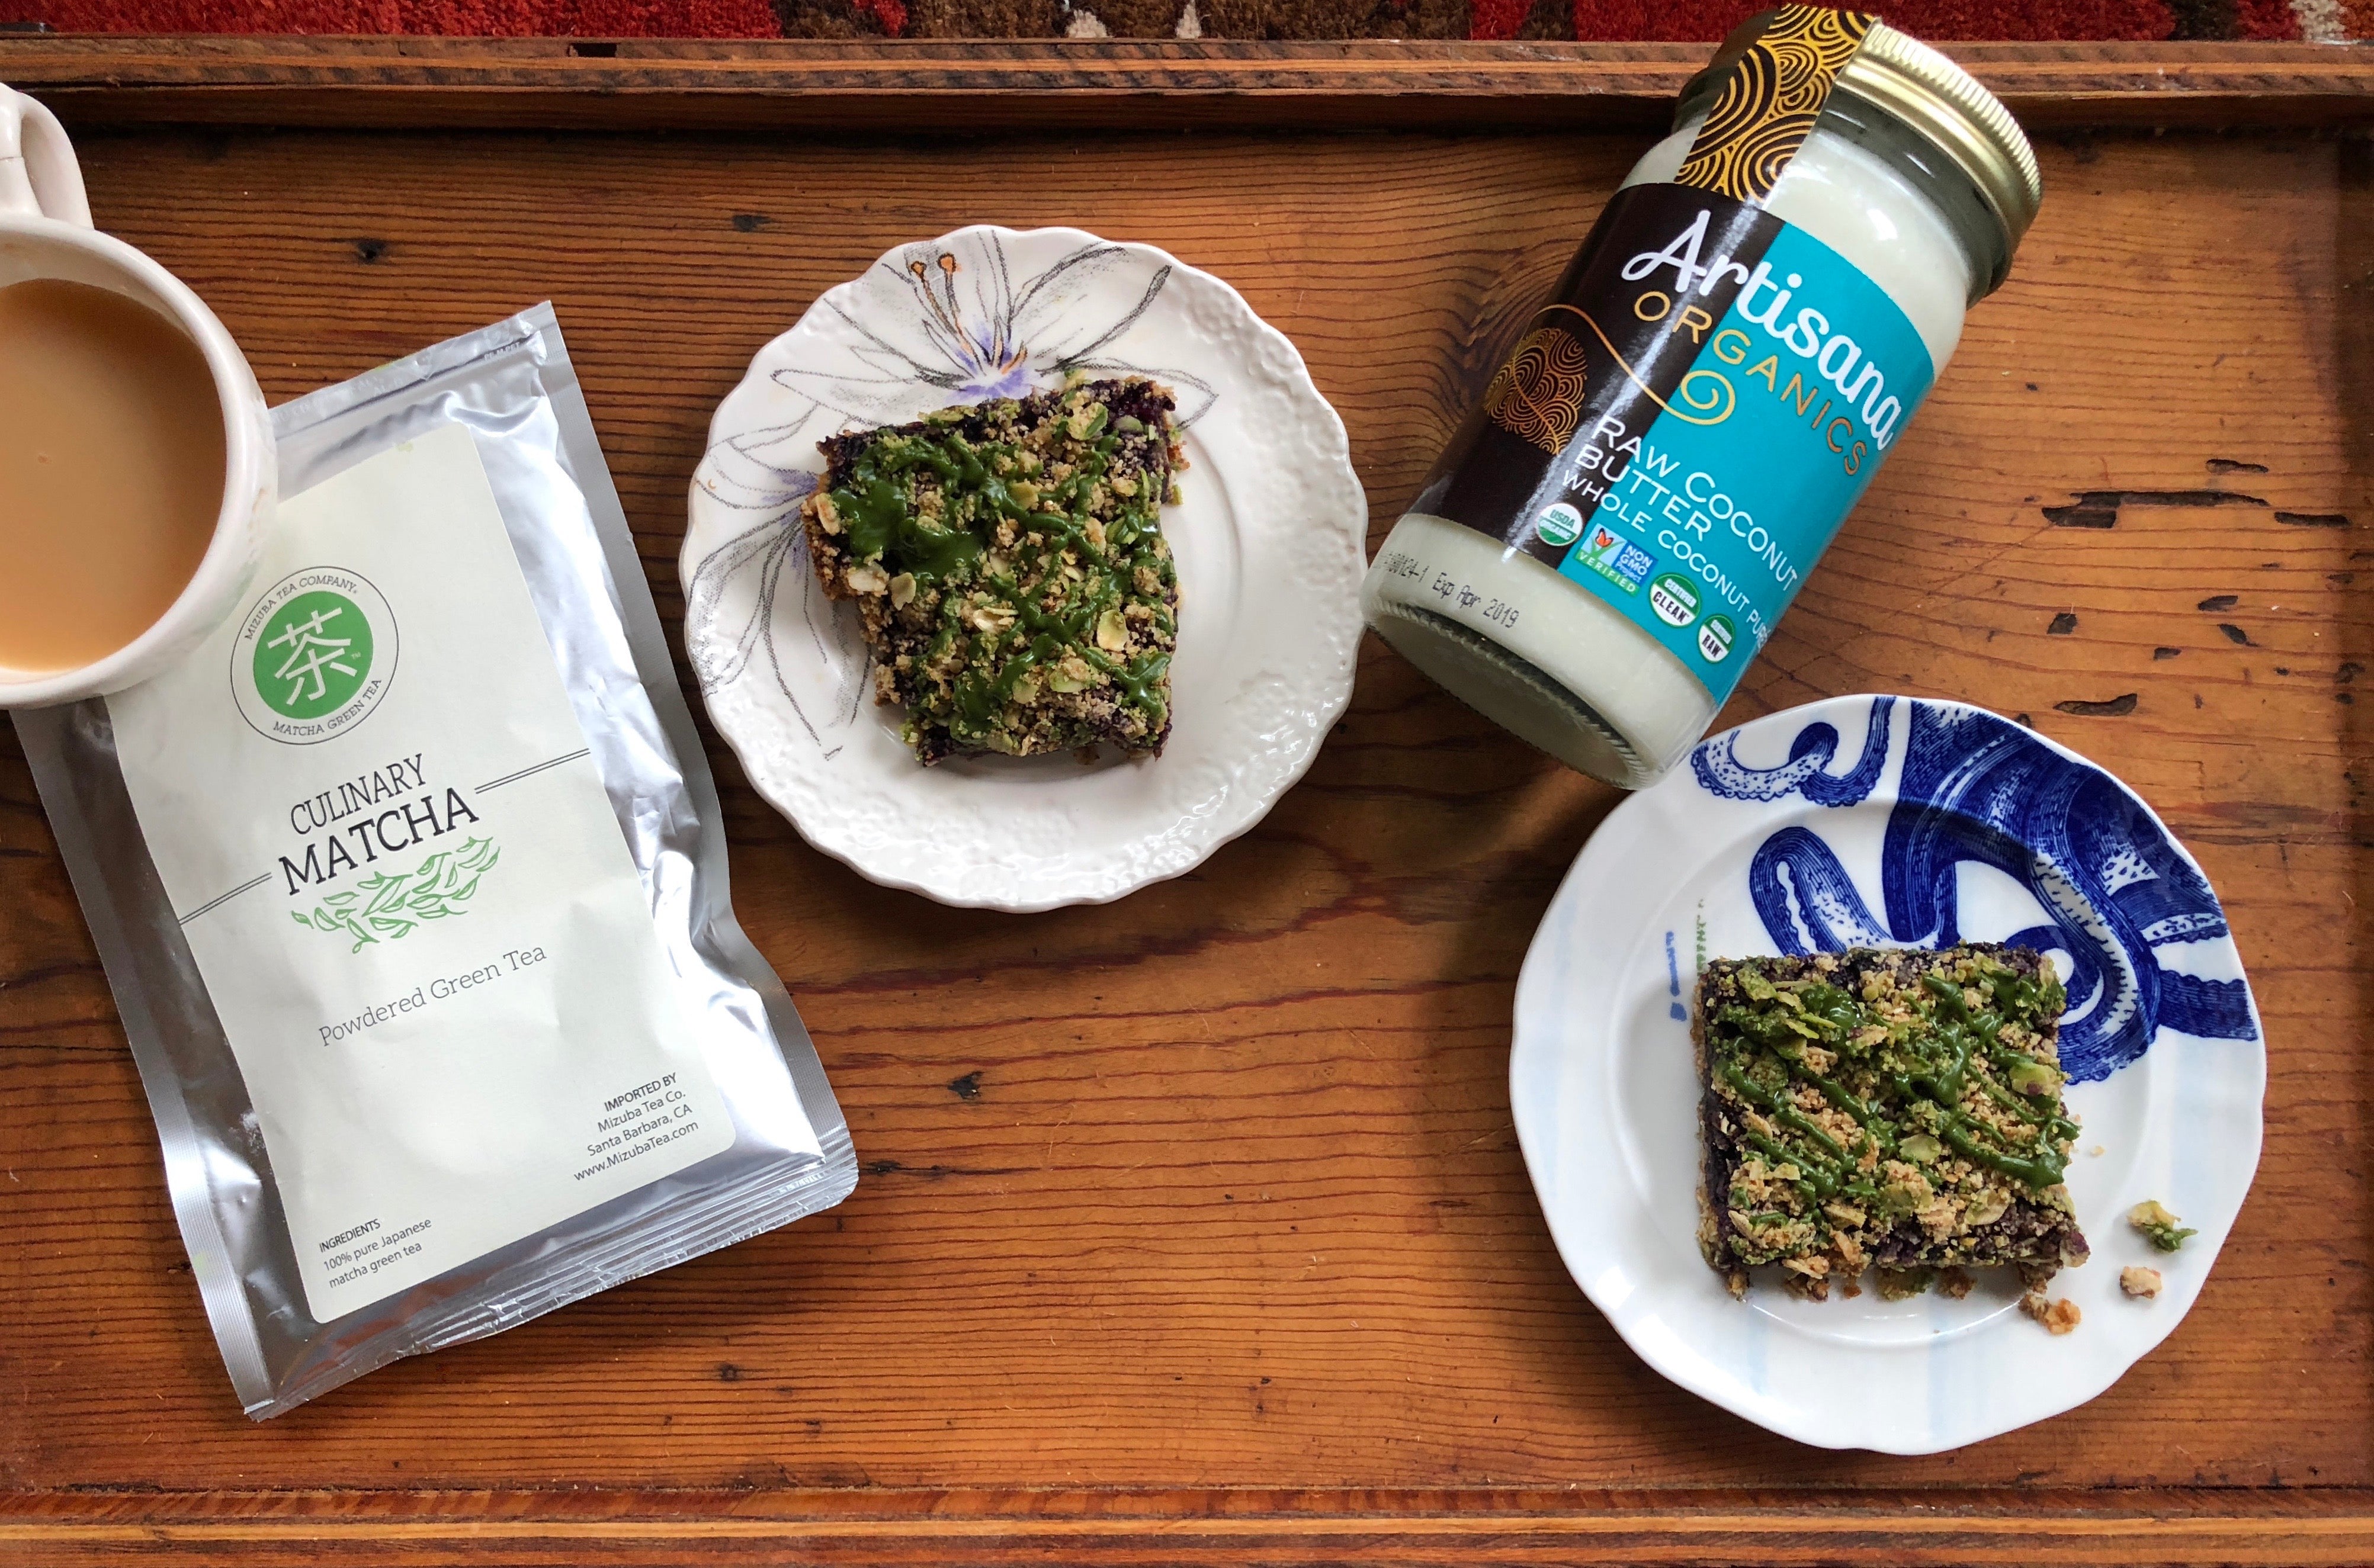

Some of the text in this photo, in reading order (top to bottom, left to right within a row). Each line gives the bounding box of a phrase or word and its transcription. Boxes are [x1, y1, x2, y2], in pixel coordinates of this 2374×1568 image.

[1621, 209, 1902, 451] Artisana
[1634, 291, 1867, 476] ORGANICS
[1549, 509, 1576, 529] USDA
[1574, 444, 1712, 542] BUTTER
[1591, 415, 1799, 591] RAW COCONUT
[1563, 470, 1653, 533] WHOLE
[1657, 529, 1750, 612] COCONUT
[1619, 554, 1648, 576] GMO
[1625, 545, 1653, 568] NON
[1579, 551, 1636, 592] VERIFIED
[244, 599, 277, 640] MIZUBA
[276, 583, 297, 600] TEA
[1432, 572, 1455, 599] Exp
[1456, 584, 1481, 609] Apr
[1483, 598, 1519, 629] 2019
[1653, 590, 1688, 624] CLEAN
[268, 607, 357, 706] 茶
[1702, 634, 1722, 658] RAW
[273, 679, 382, 736] MATCHA GREEN TEA
[291, 753, 426, 835] CULINARY
[278, 788, 480, 896] MATCHA
[319, 946, 547, 1047] Powdered Green Tea
[597, 1090, 686, 1133] Mizuba Tea Co.
[604, 1072, 677, 1112] IMPORTED BY
[573, 1122, 700, 1181] www.MizubaTea.com
[587, 1103, 693, 1156] Santa Barbara, CA
[319, 1218, 381, 1253] INGREDIENTS
[323, 1219, 432, 1271] 100% pure Japanese
[329, 1242, 422, 1289] matcha green tea
